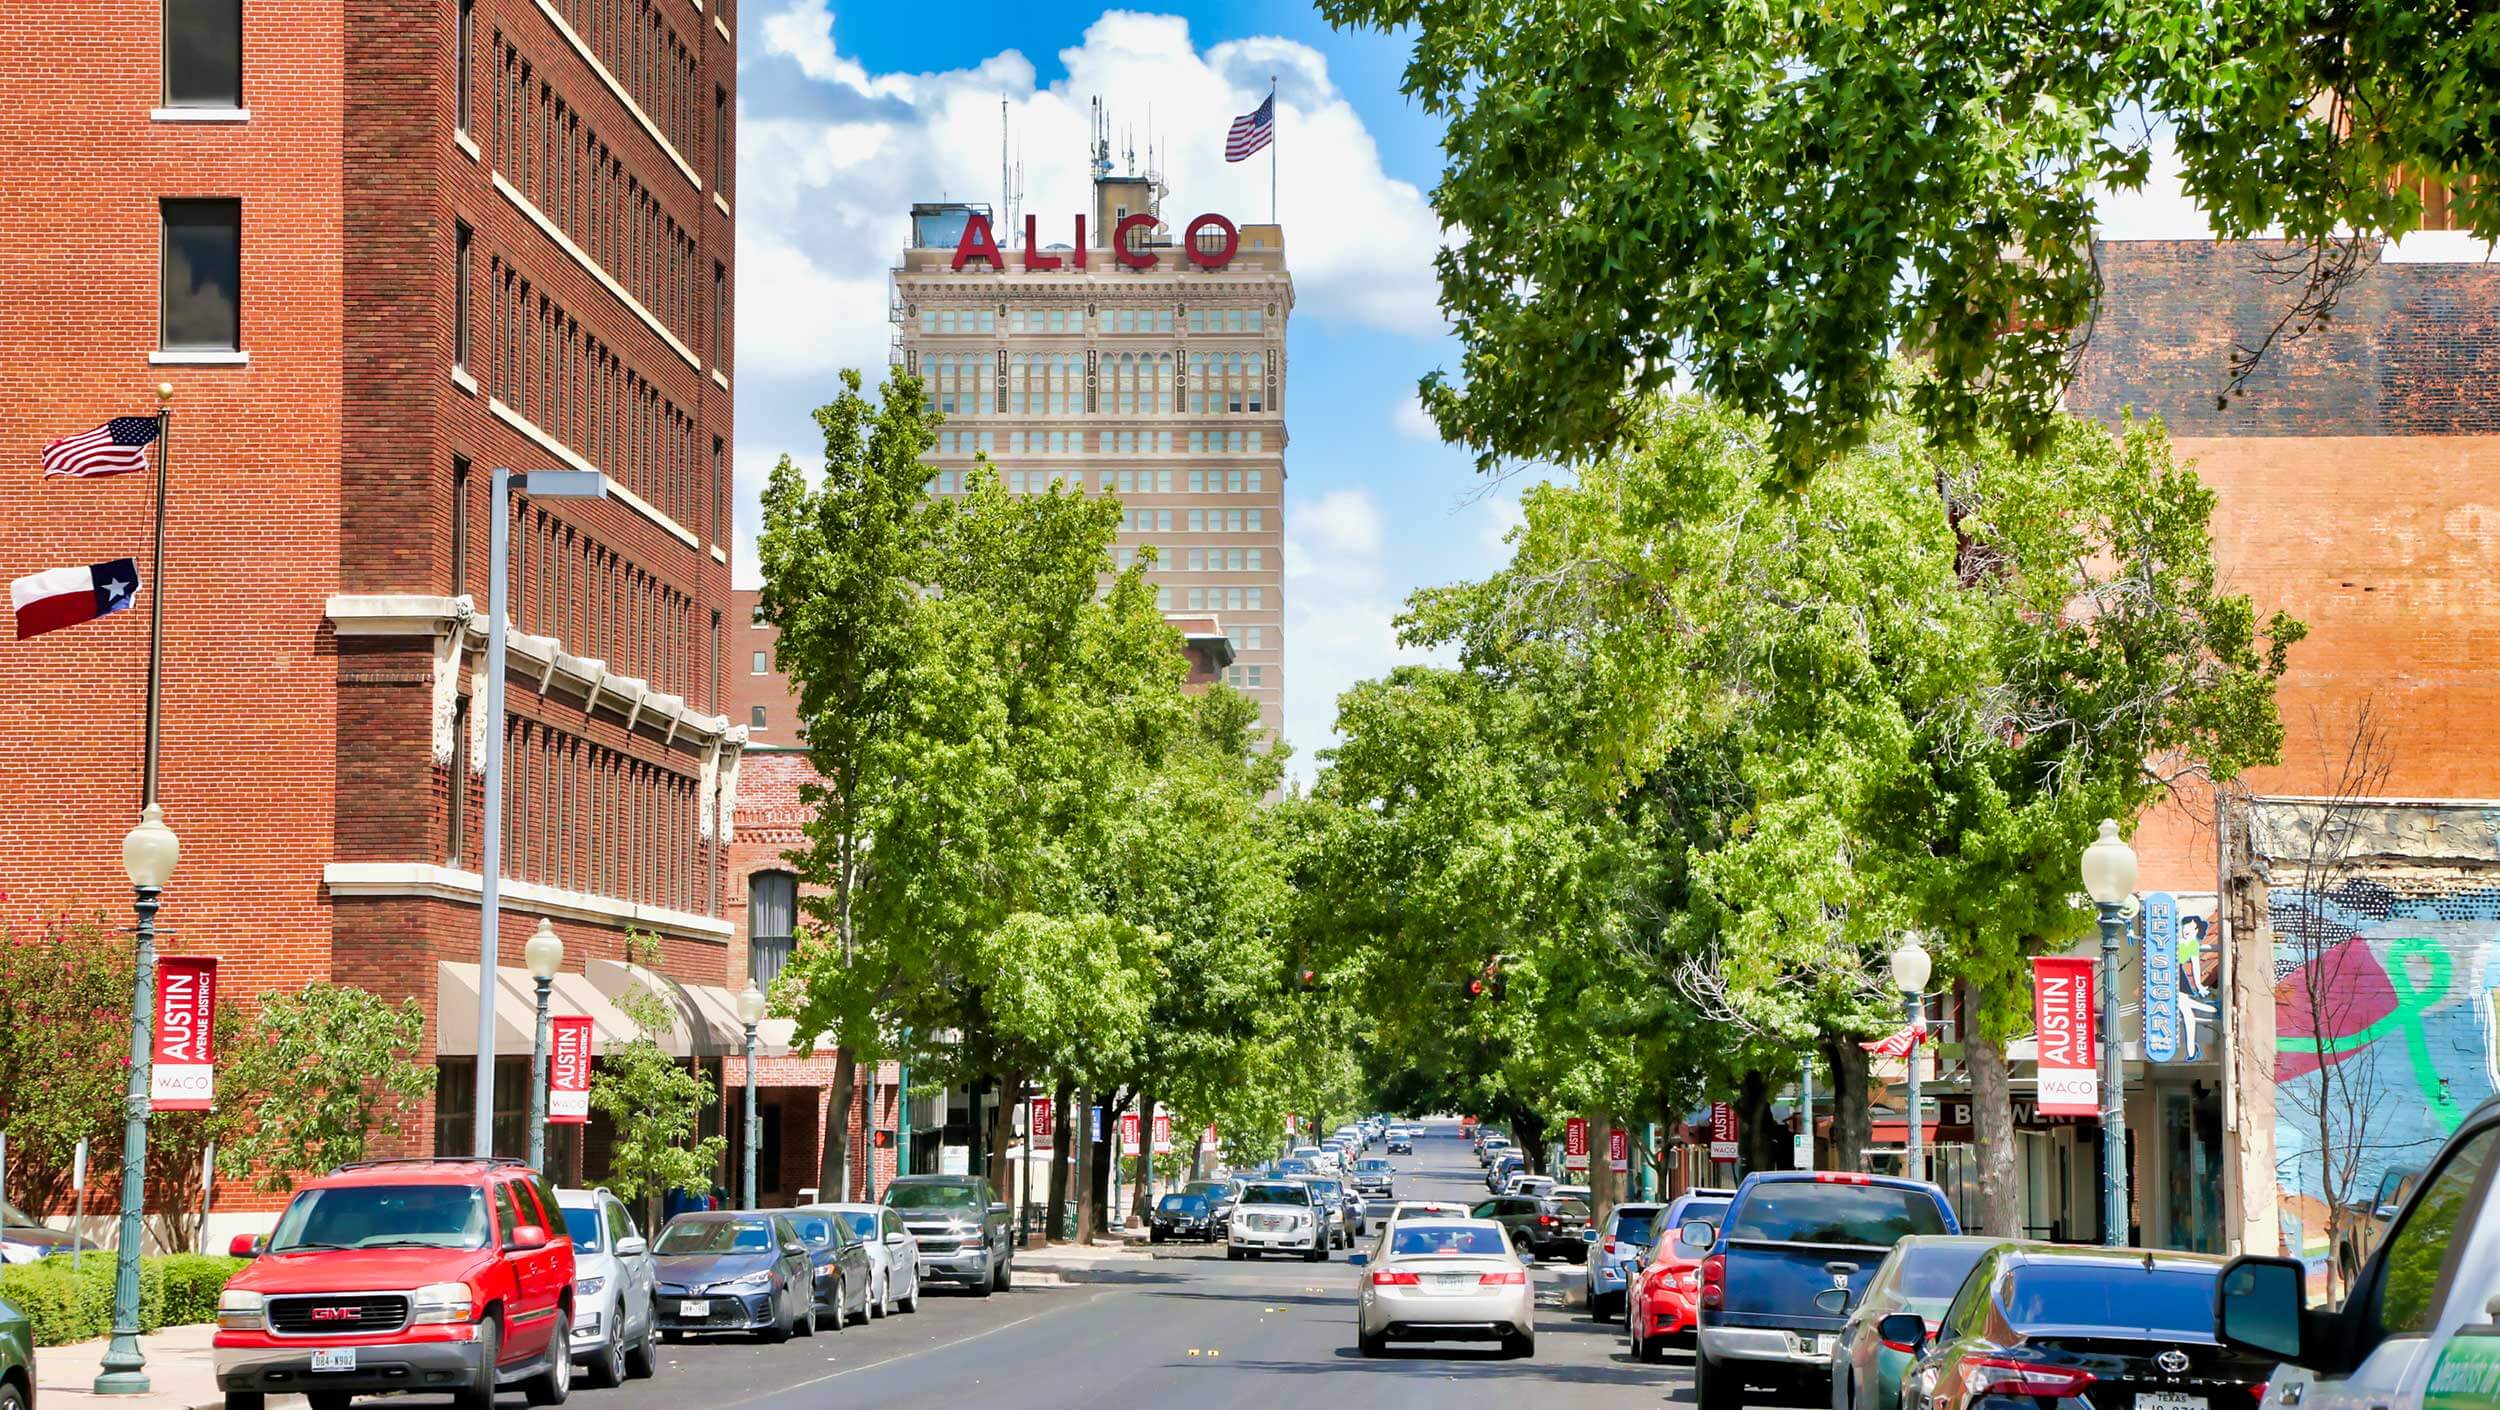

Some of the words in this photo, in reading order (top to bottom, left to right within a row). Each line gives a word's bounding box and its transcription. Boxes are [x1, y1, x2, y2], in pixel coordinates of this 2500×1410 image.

[951, 213, 1238, 269] ALICO
[2151, 903, 2170, 949] HEY
[198, 972, 210, 1016] DISTRICT
[2075, 975, 2087, 1019] DISTRICT
[2150, 954, 2171, 1037] SUGAR
[162, 975, 193, 1061] AUSTIN
[196, 1018, 209, 1060] AVENUE
[2042, 977, 2071, 1064] AUSTIN
[556, 1028, 577, 1088] AUSTIN
[2075, 1022, 2087, 1065] AVENUE
[158, 1076, 208, 1090] WACO
[2043, 1081, 2093, 1095] WACO
[1034, 1104, 1044, 1134] AUSTIN
[1568, 1124, 1579, 1154] AUSTIN
[1714, 1101, 1727, 1140] AUSTIN
[1612, 1135, 1620, 1159] AUSTIN
[1713, 1146, 1736, 1154] WACO
[311, 1306, 362, 1320] GMC
[2158, 1394, 2187, 1403] TEXAS
